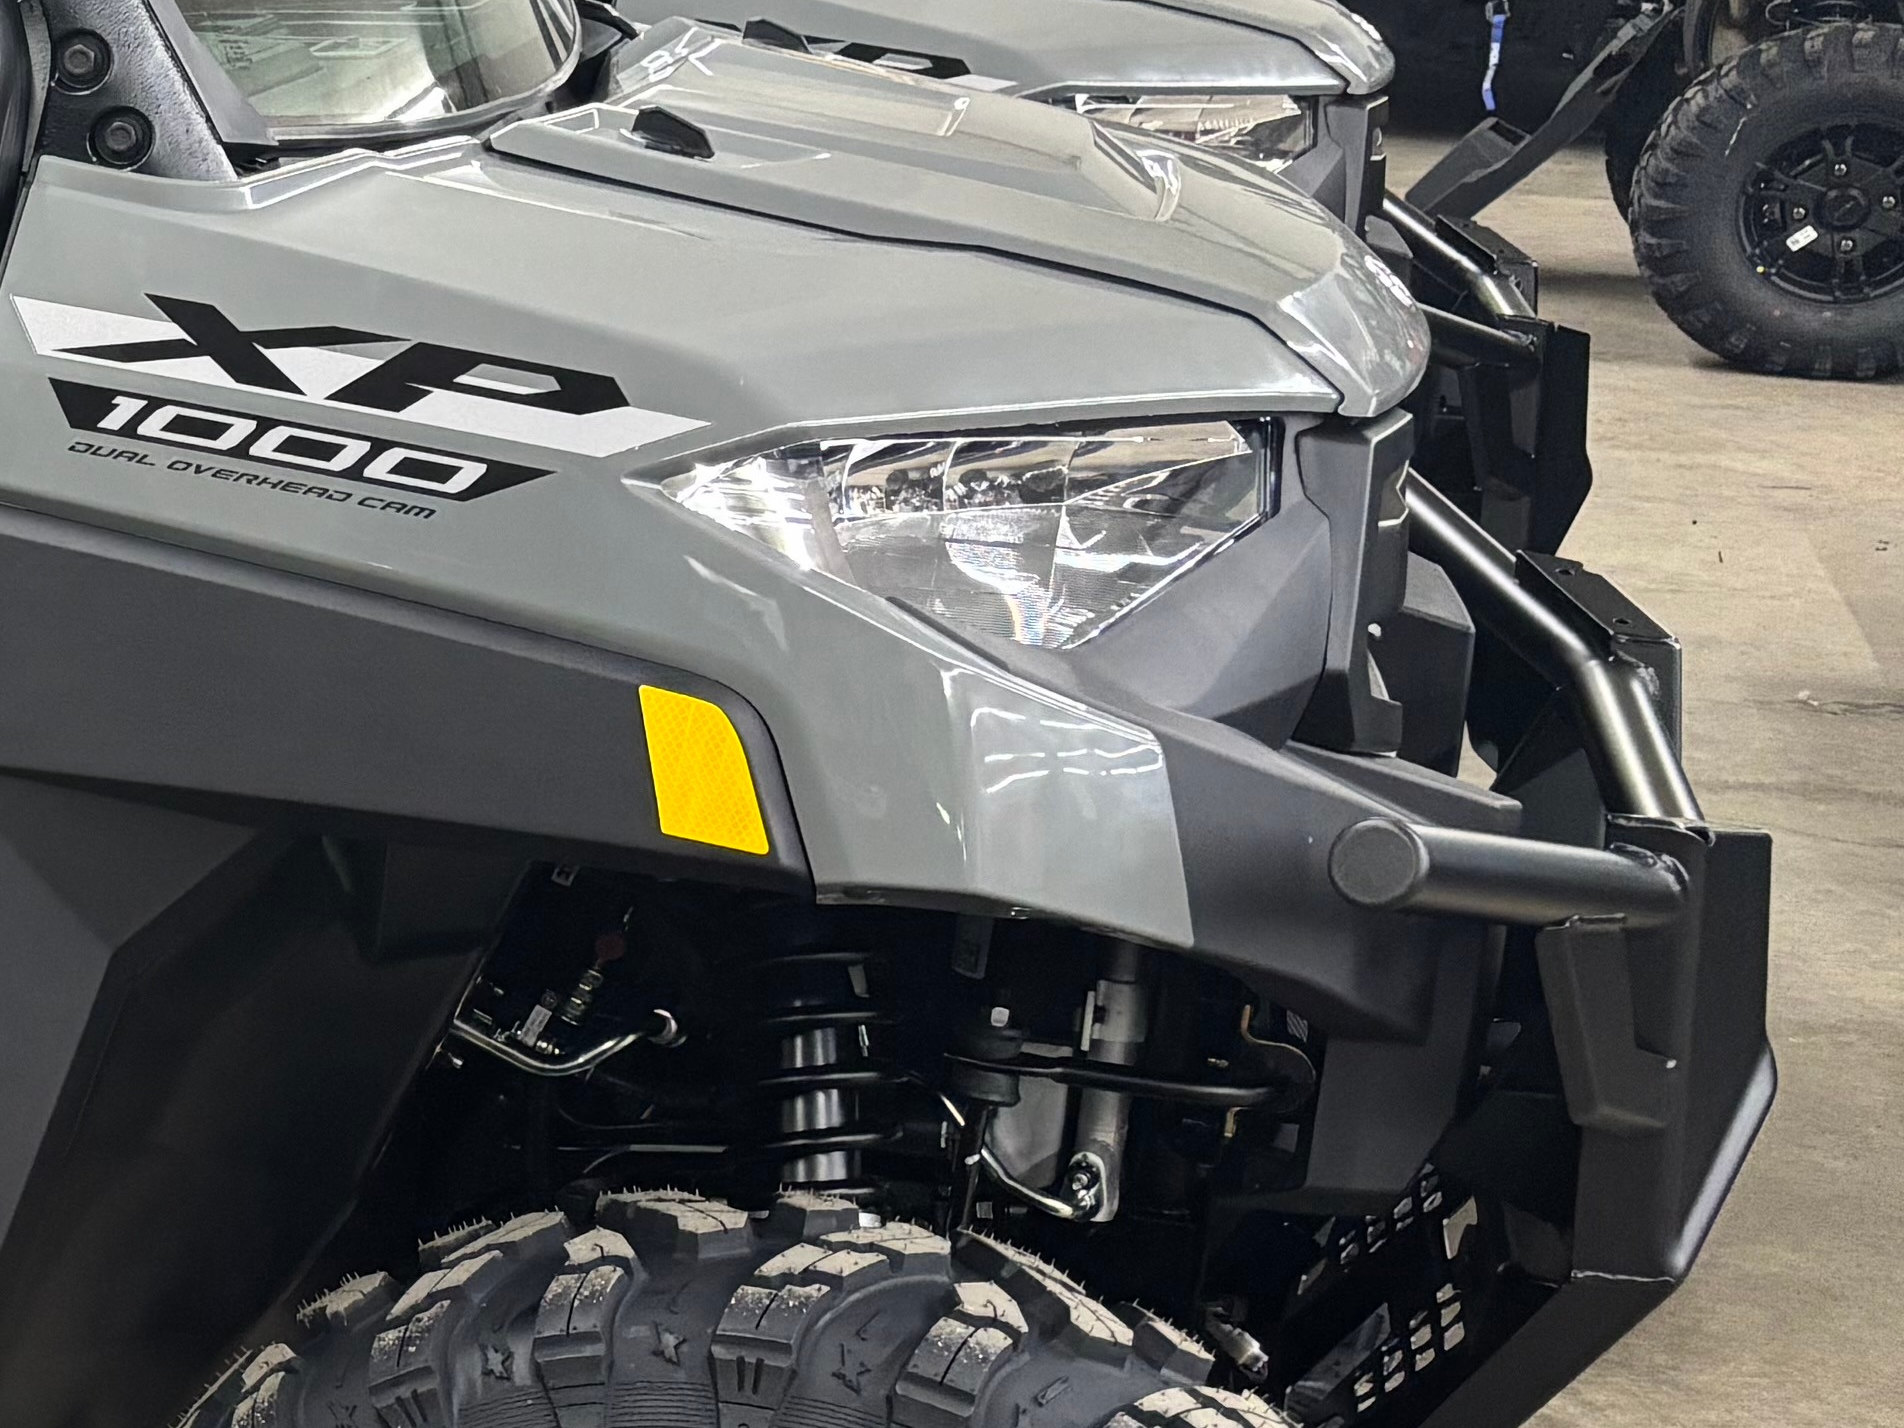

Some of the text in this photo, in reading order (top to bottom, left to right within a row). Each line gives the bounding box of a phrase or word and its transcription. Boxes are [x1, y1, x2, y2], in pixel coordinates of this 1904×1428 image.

[50, 292, 632, 416] XP
[67, 440, 437, 520] DUAL OVERHEAD CAM
[95, 395, 489, 495] 1000
